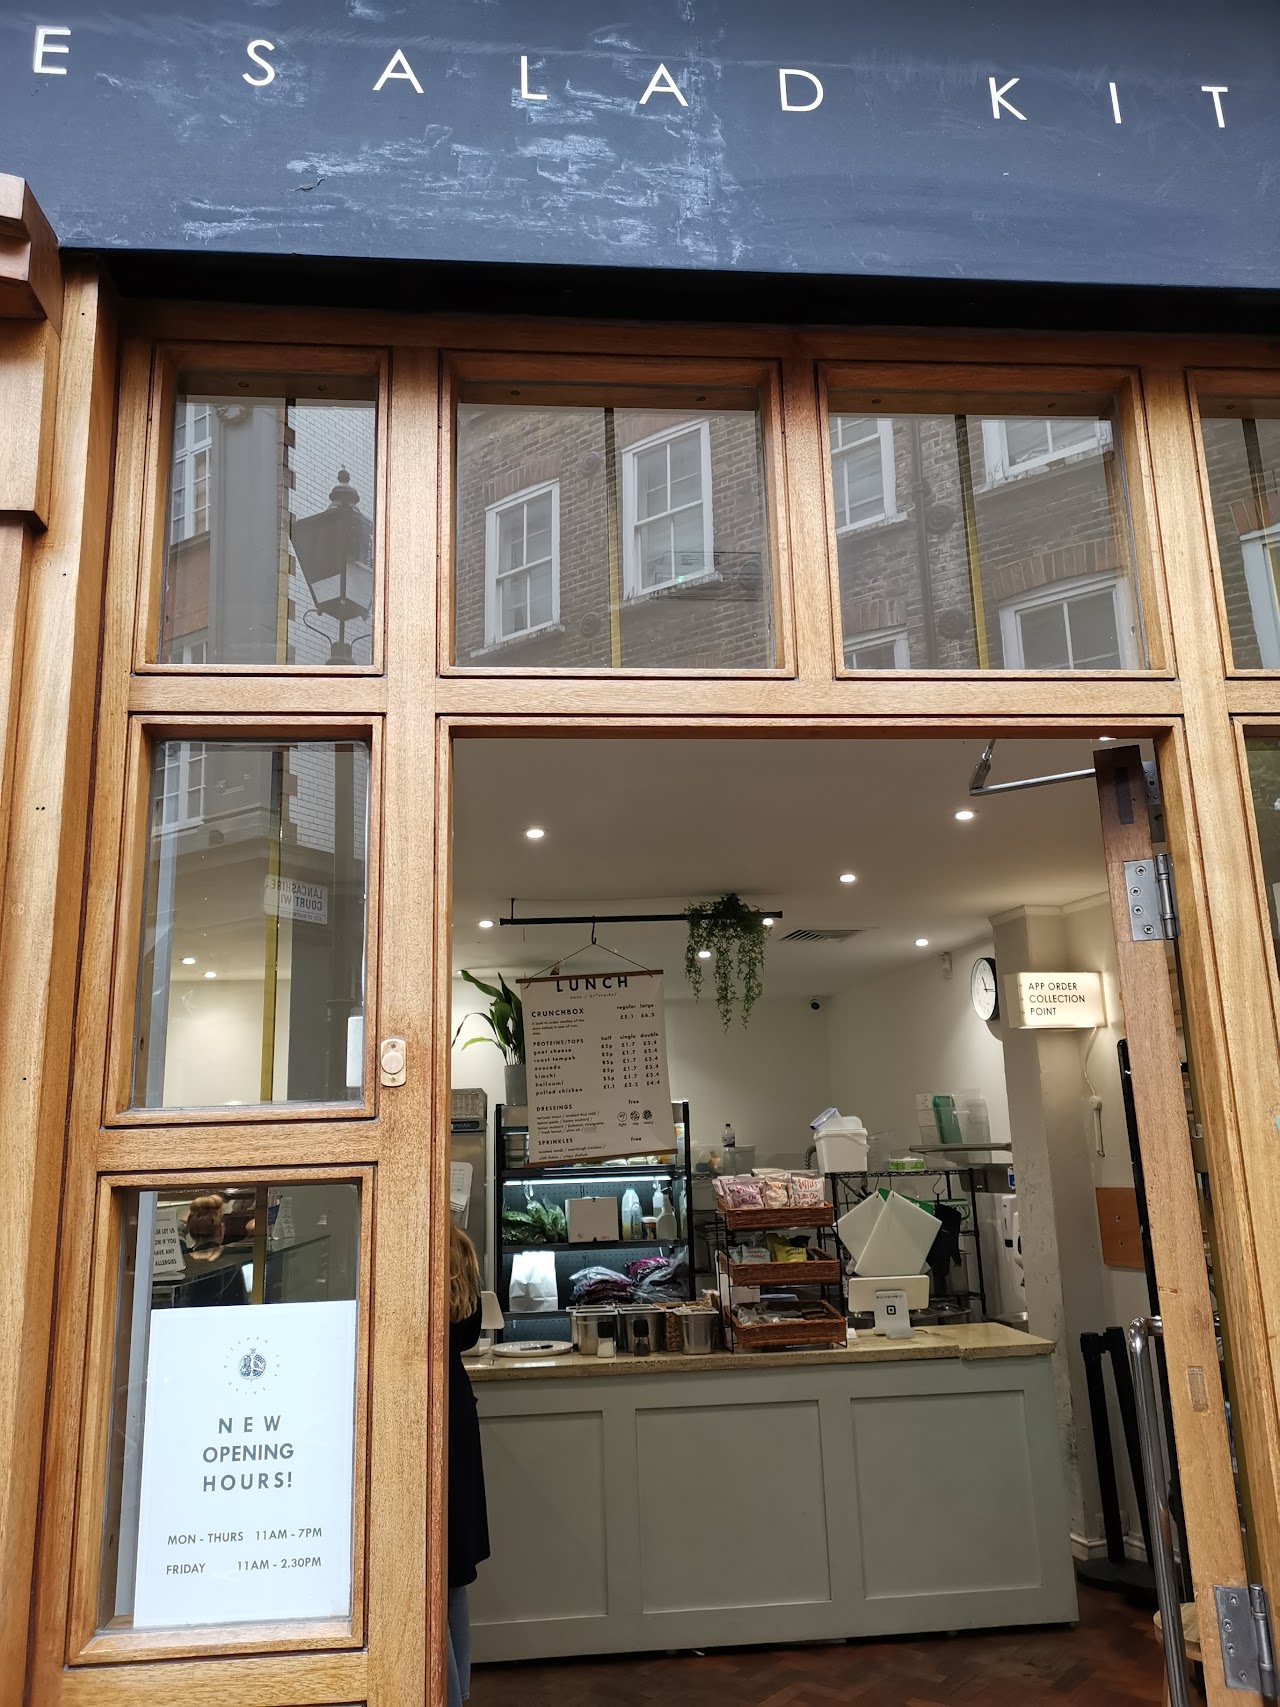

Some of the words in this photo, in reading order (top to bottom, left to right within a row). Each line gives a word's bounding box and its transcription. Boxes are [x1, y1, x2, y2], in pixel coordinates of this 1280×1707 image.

[33, 25, 71, 75] E
[242, 39, 824, 113] SALAD
[989, 77, 1229, 128] KIT
[556, 975, 628, 992] LUNCH
[1028, 982, 1045, 991] APP
[1047, 982, 1078, 991] ORDER
[1029, 994, 1086, 1003] COLLECTION
[531, 1008, 584, 1018] CRUNCHBOX
[1030, 1007, 1057, 1016] POINT
[533, 1038, 584, 1047] PROTEINS/TOPS
[536, 1104, 573, 1112] DRESSINGS
[538, 1138, 574, 1146] SPRINKLES
[155, 1258, 177, 1266] ALLERGIES
[218, 1415, 281, 1434] NEW
[202, 1443, 294, 1463] OPENING
[203, 1471, 293, 1492] HOURS!
[167, 1534, 197, 1545] MON
[207, 1531, 244, 1543] THURS
[255, 1529, 288, 1541] 11AM
[298, 1527, 323, 1538] 7PM
[166, 1563, 206, 1575] FRIDAY
[237, 1559, 270, 1571] 11AM
[280, 1556, 322, 1569] 2.30PM
